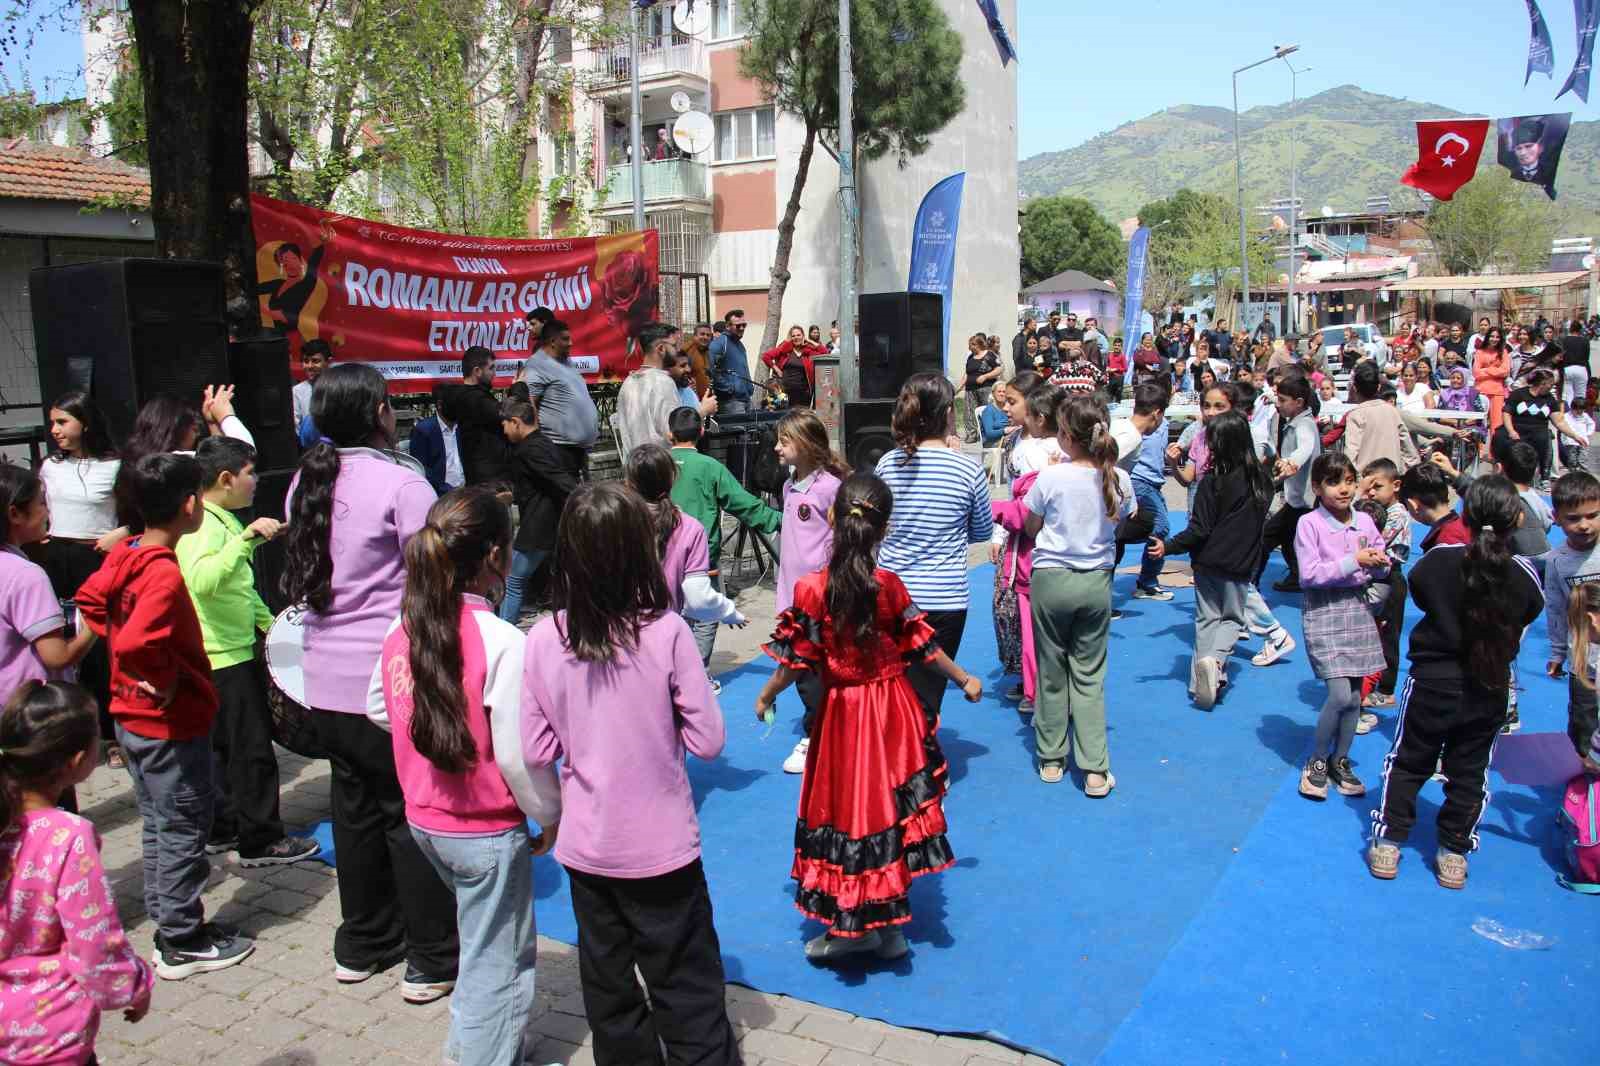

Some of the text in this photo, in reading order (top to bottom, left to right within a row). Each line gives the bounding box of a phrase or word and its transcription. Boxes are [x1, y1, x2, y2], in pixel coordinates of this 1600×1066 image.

[452, 254, 508, 275] DÜNYA
[345, 262, 592, 312] ROMANLAR GÜNÜ
